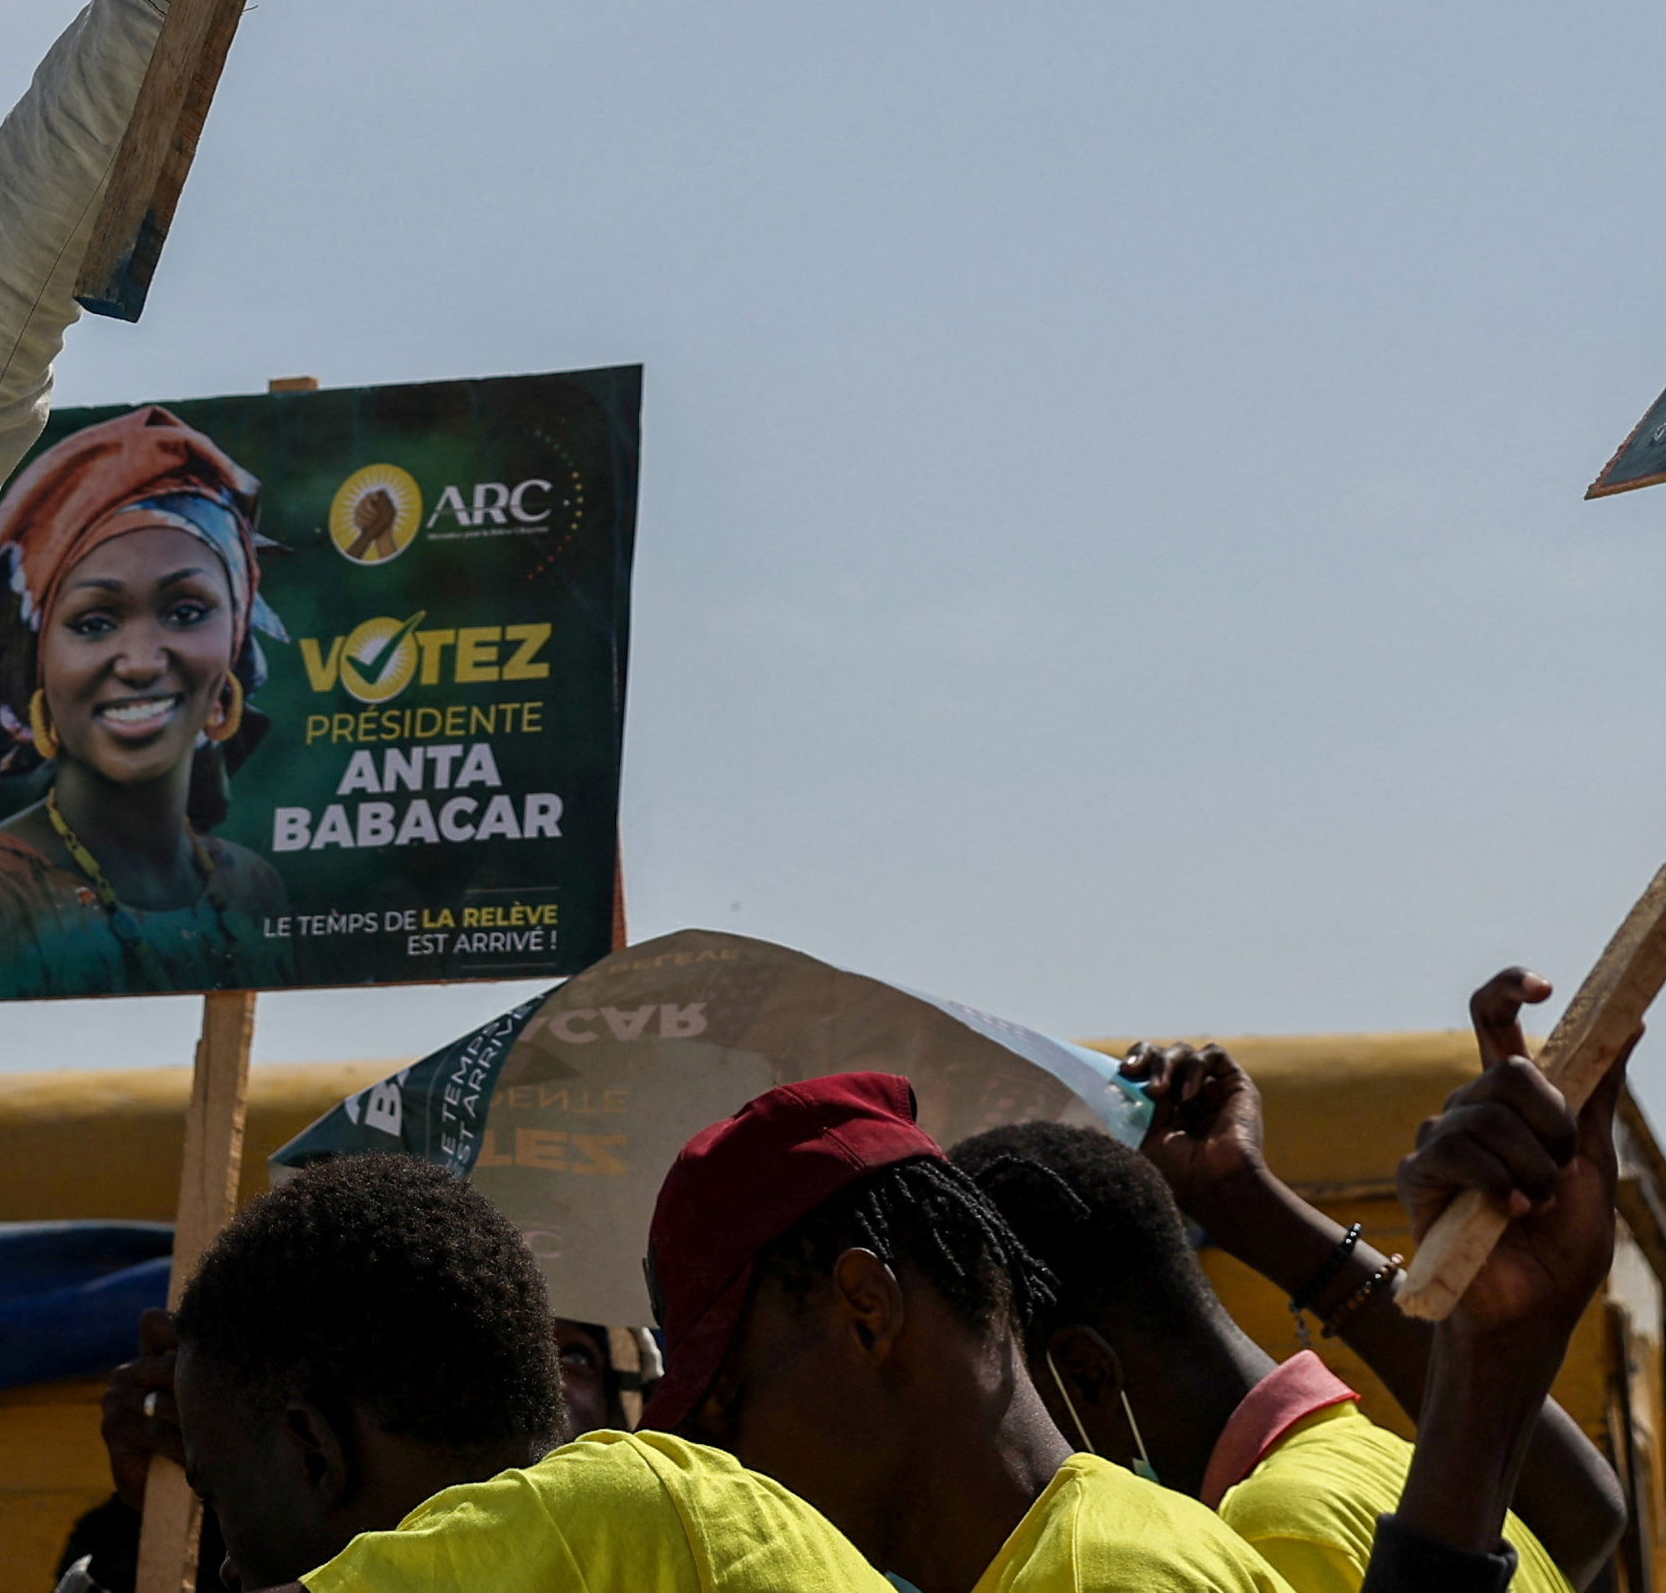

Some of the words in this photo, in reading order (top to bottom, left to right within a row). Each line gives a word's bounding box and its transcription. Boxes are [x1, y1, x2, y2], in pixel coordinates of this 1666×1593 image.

[426, 478, 553, 529] ARC
[298, 610, 553, 705] VOTEZ
[305, 701, 544, 746] PRÉSIDENTE
[336, 742, 503, 796] ANTA
[271, 792, 565, 853] BABACAR
[263, 916, 292, 938] LE
[298, 911, 379, 936] TEMPS
[384, 909, 418, 932] DE
[421, 907, 456, 929] LA
[461, 900, 559, 927] RELÈVE
[406, 933, 449, 956] EST
[453, 926, 545, 955] ARRIVÉ
